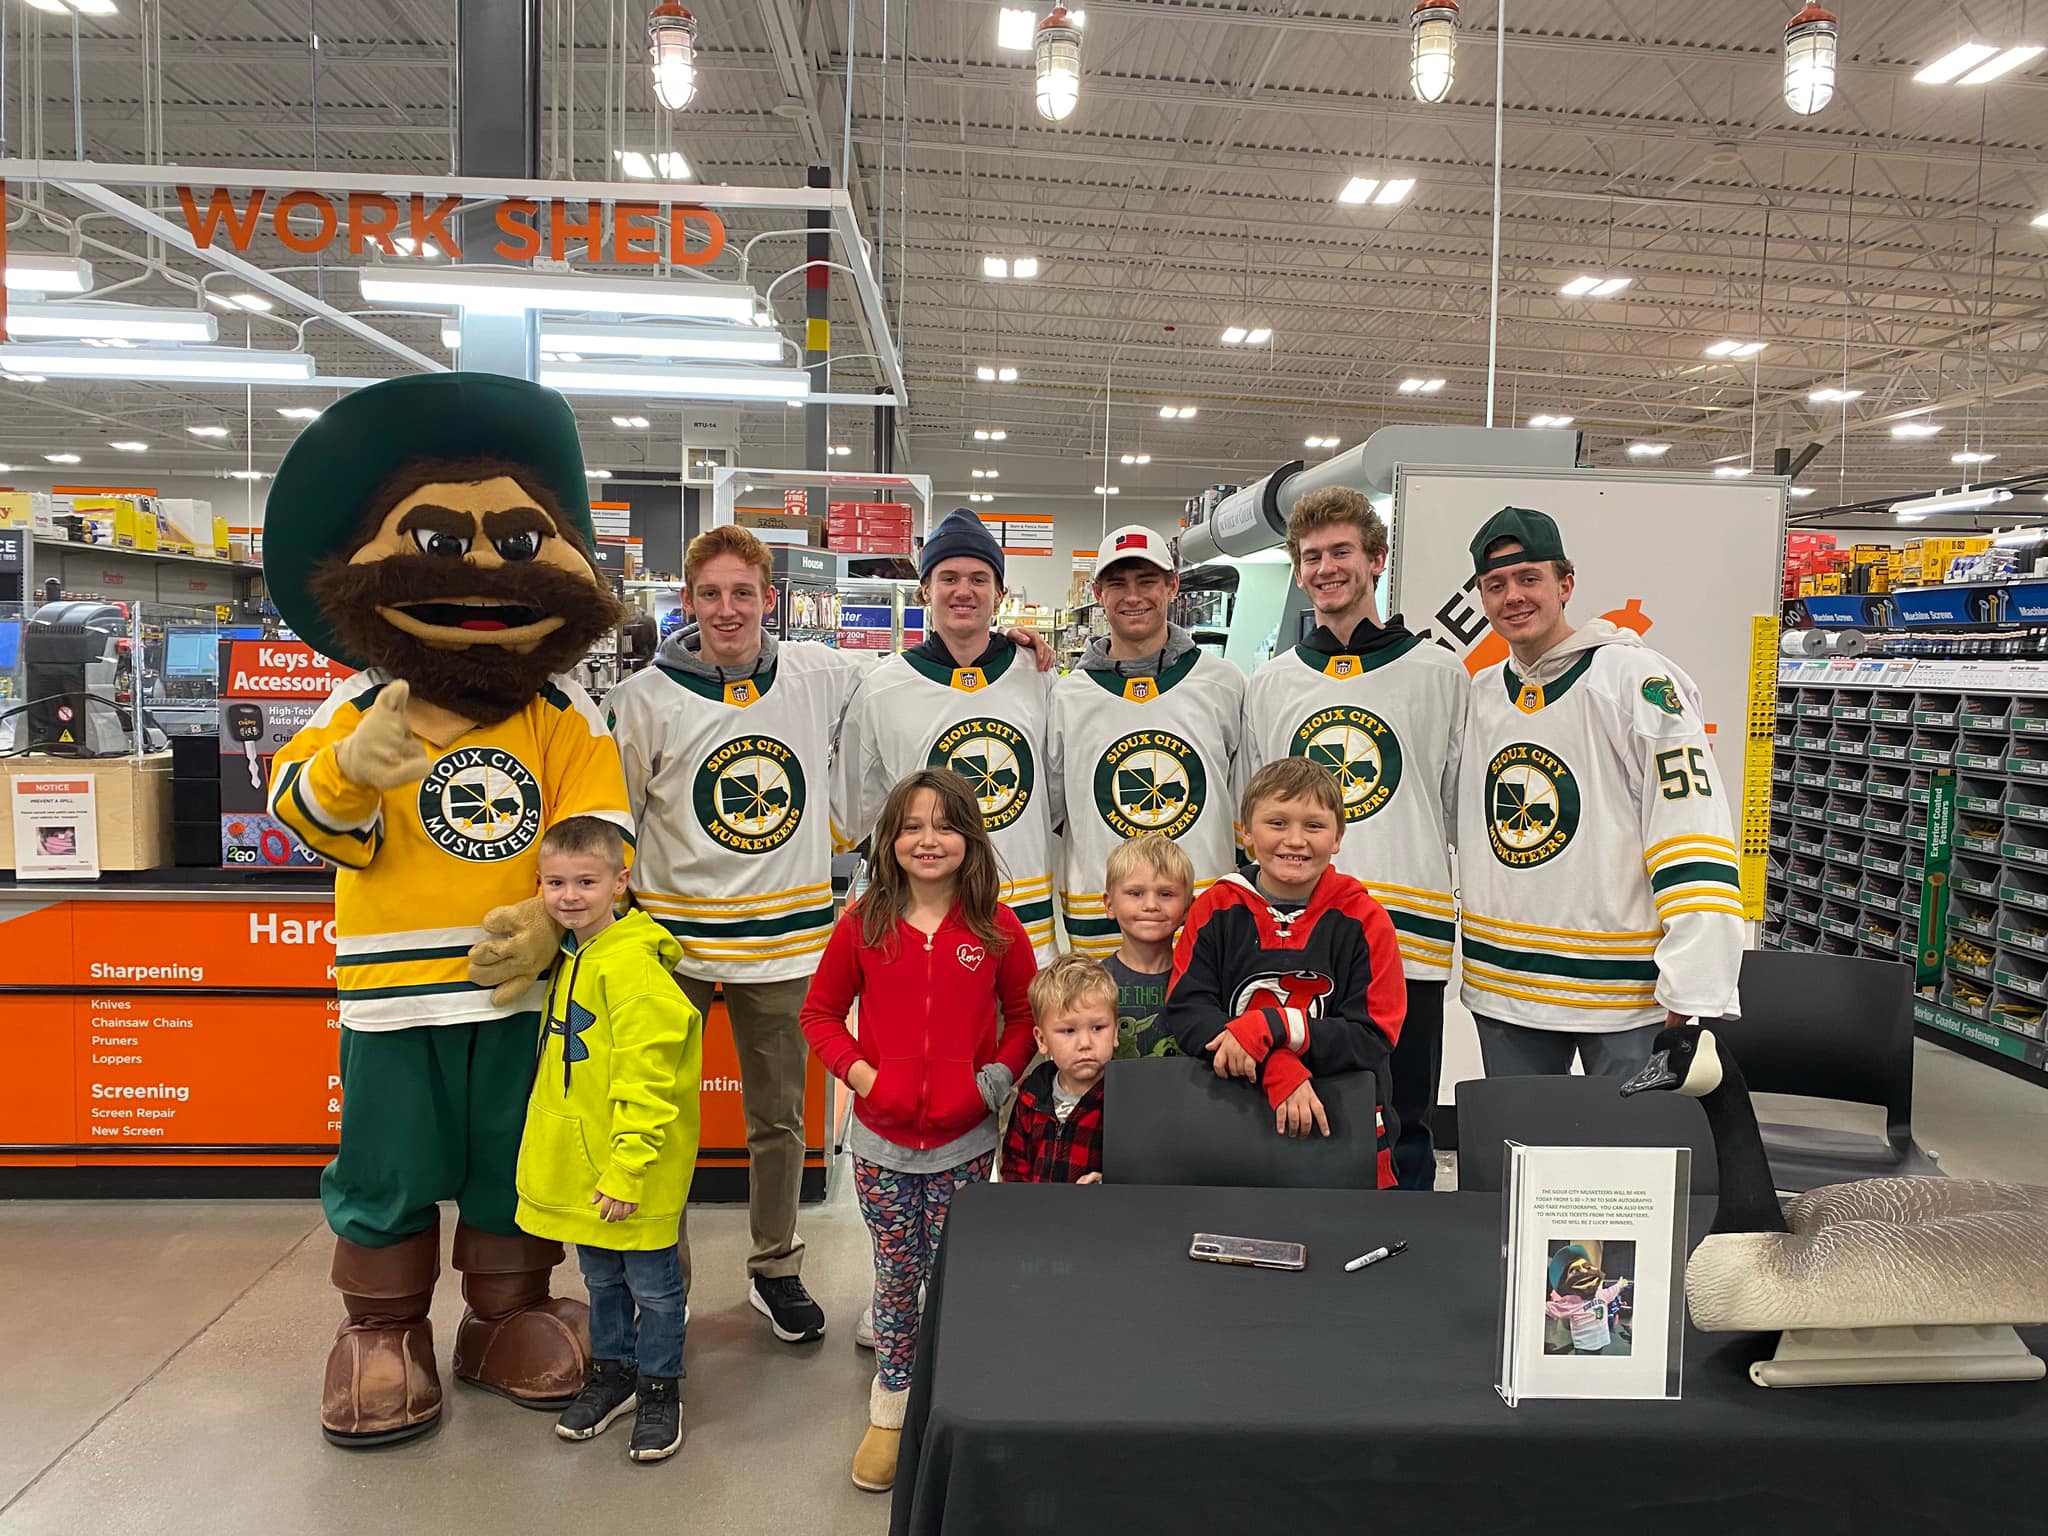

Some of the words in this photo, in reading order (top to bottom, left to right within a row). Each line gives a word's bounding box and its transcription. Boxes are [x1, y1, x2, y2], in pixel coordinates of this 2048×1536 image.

[176, 185, 463, 258] WORK
[495, 199, 726, 265] SHED
[594, 551, 607, 561] ve
[802, 556, 824, 570] House
[258, 647, 308, 673] Keys
[233, 671, 344, 692] Accessorie
[268, 717, 291, 725] Auto
[1300, 709, 1345, 740] SIOUX
[1348, 710, 1388, 736] CITY
[938, 721, 983, 753] SIOUX
[985, 722, 1022, 745] CITY
[1106, 734, 1151, 764] SIOUX
[1154, 734, 1191, 758] CITY
[707, 739, 754, 772] SIOUX
[756, 740, 791, 762] CITY
[1490, 747, 1528, 775] SIOUX
[1530, 749, 1567, 778] CITY
[35, 783, 70, 791] NOTICE
[425, 750, 484, 795] SIOUX
[491, 753, 534, 787] CITY
[1654, 746, 1713, 801] 55
[982, 789, 1028, 828] ETEERS
[1343, 785, 1390, 819] TEERS
[1933, 787, 1943, 820] Coated
[425, 808, 538, 858] MUSKETEERS
[707, 807, 800, 850] MUSKETEERS
[1939, 800, 1950, 845] Fasteners
[1930, 821, 1941, 857] Exterior
[90, 962, 204, 981] Sharpening
[91, 999, 131, 1010] Knives
[1133, 985, 1160, 1006] THIS
[91, 1017, 149, 1028] Chainsaw
[153, 1017, 193, 1028] Chains
[1935, 1013, 1961, 1031] Coated
[1962, 1023, 2000, 1047] Fasteners
[91, 1035, 138, 1046] Pruners
[92, 1053, 142, 1065] Loppers
[91, 1083, 190, 1102] Screening
[91, 1107, 133, 1119] Screen
[136, 1107, 176, 1120] Repair
[91, 1126, 119, 1136] New
[122, 1126, 164, 1136] Screen
